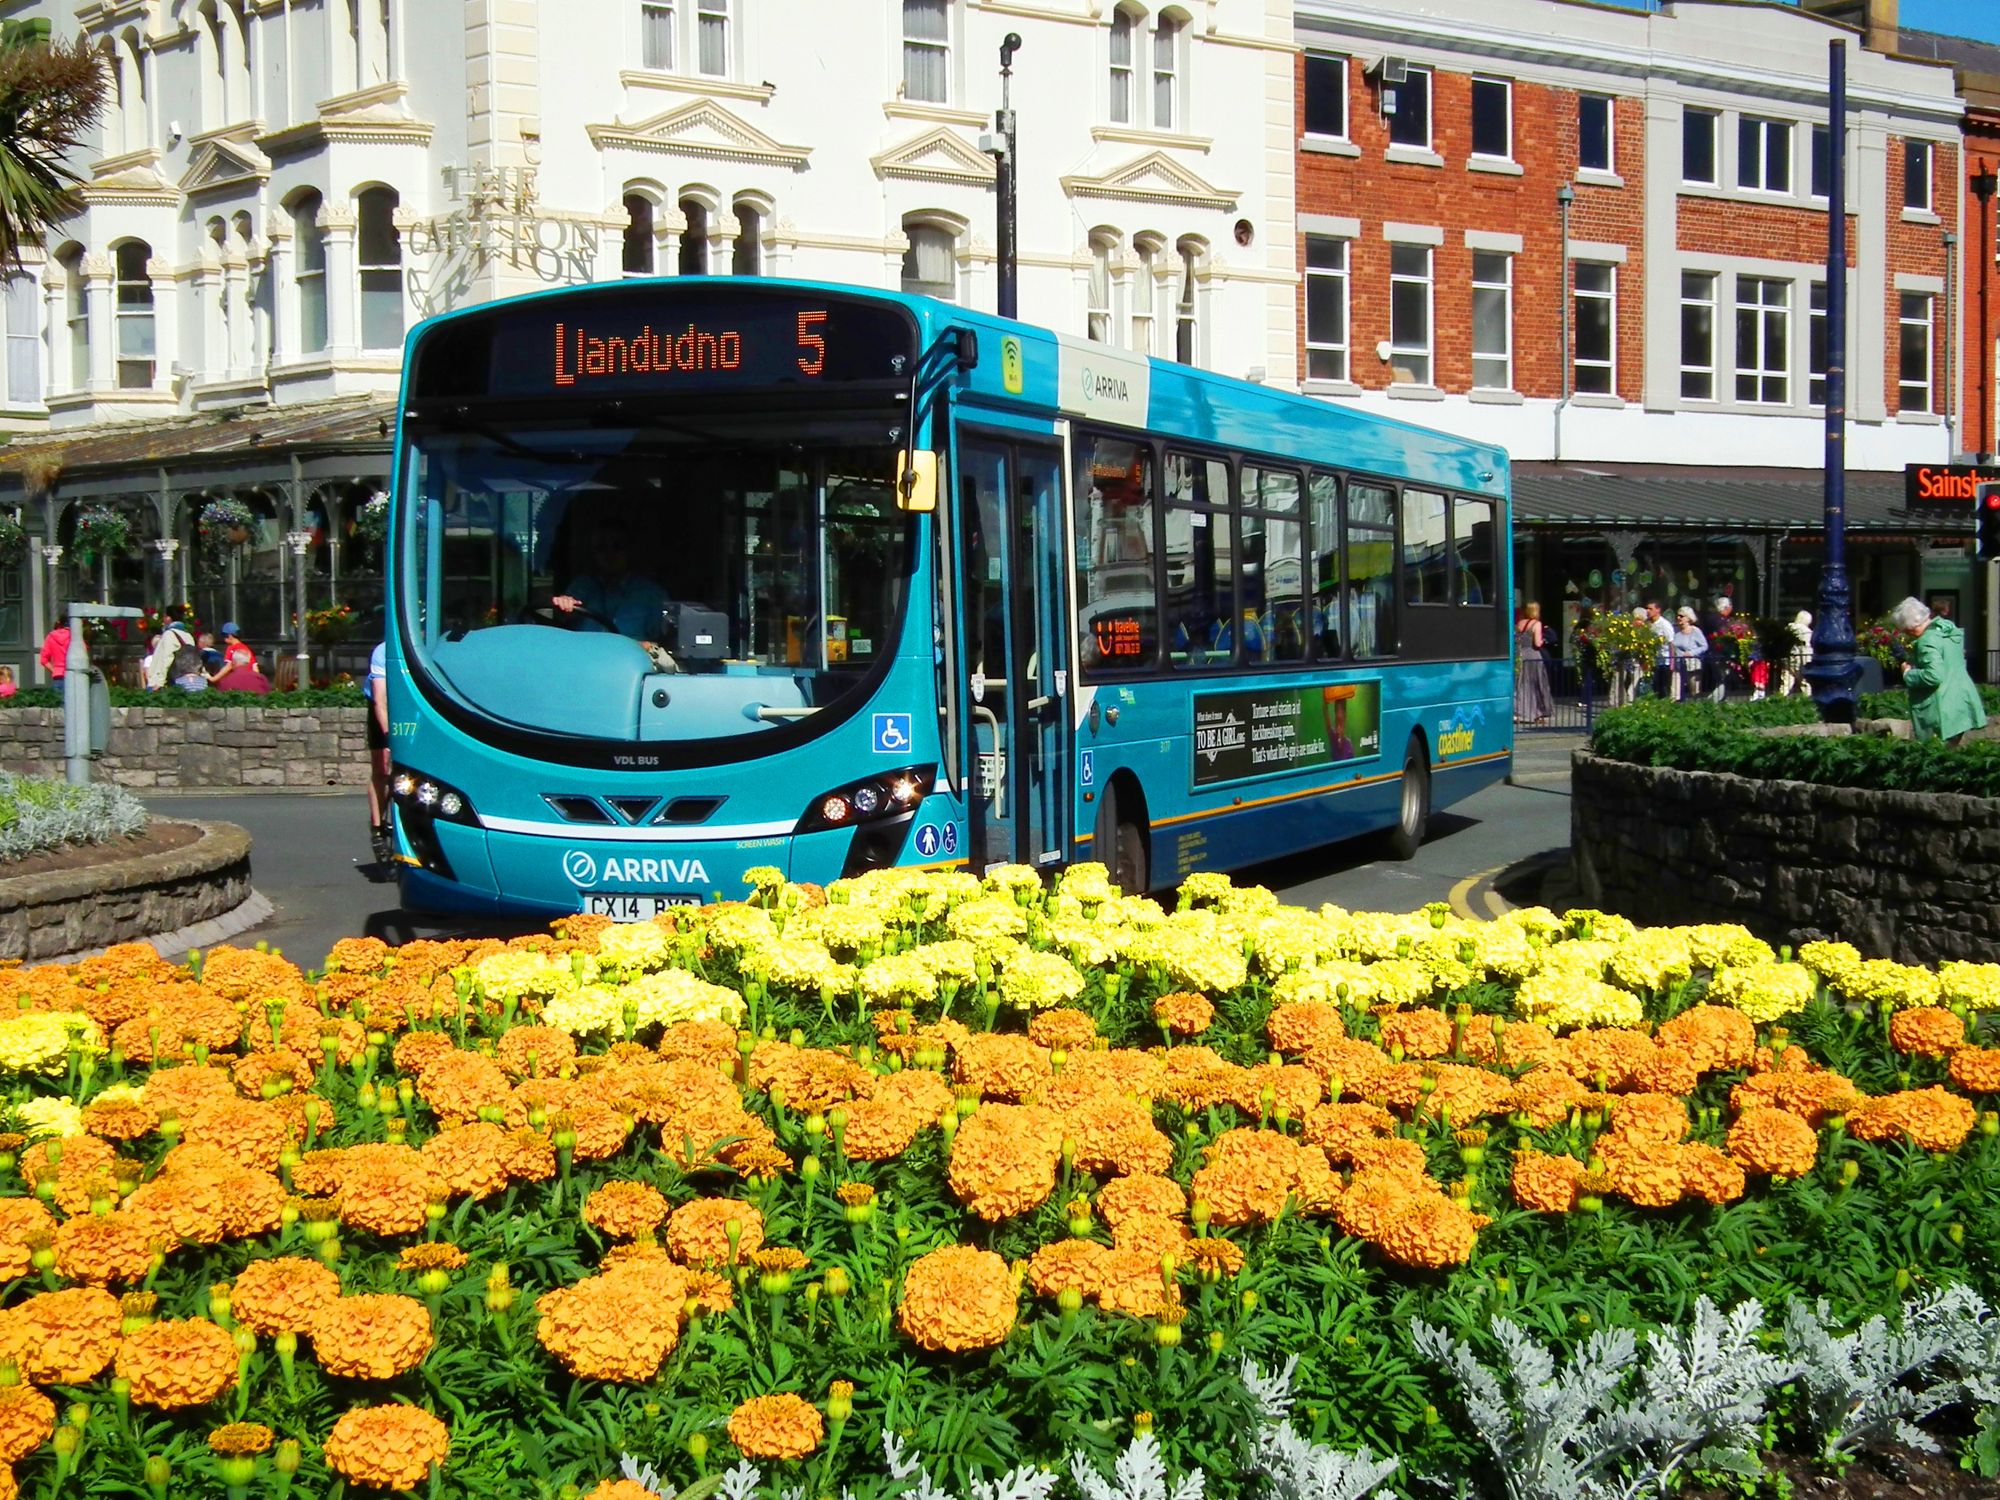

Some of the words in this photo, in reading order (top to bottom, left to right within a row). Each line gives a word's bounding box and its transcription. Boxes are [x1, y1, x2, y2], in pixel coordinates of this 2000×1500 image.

[441, 165, 541, 202] THE
[409, 213, 599, 256] CARLTON
[555, 323, 740, 384] Llandudno
[798, 310, 827, 375] 5
[1095, 375, 1129, 402] ARRIVA
[1918, 467, 1996, 498] Sainsb
[1115, 617, 1140, 633] traveline
[392, 722, 417, 736] 3177
[1196, 731, 1206, 749] TO
[1207, 730, 1216, 748] BE
[1216, 728, 1222, 747] A
[1439, 722, 1475, 755] coastliner
[614, 756, 635, 766] VDL
[638, 756, 660, 766] BUS
[736, 839, 763, 849] SCREEN
[763, 837, 785, 847] WASH
[602, 857, 711, 884] ARRIVA
[592, 897, 640, 918] CX14
